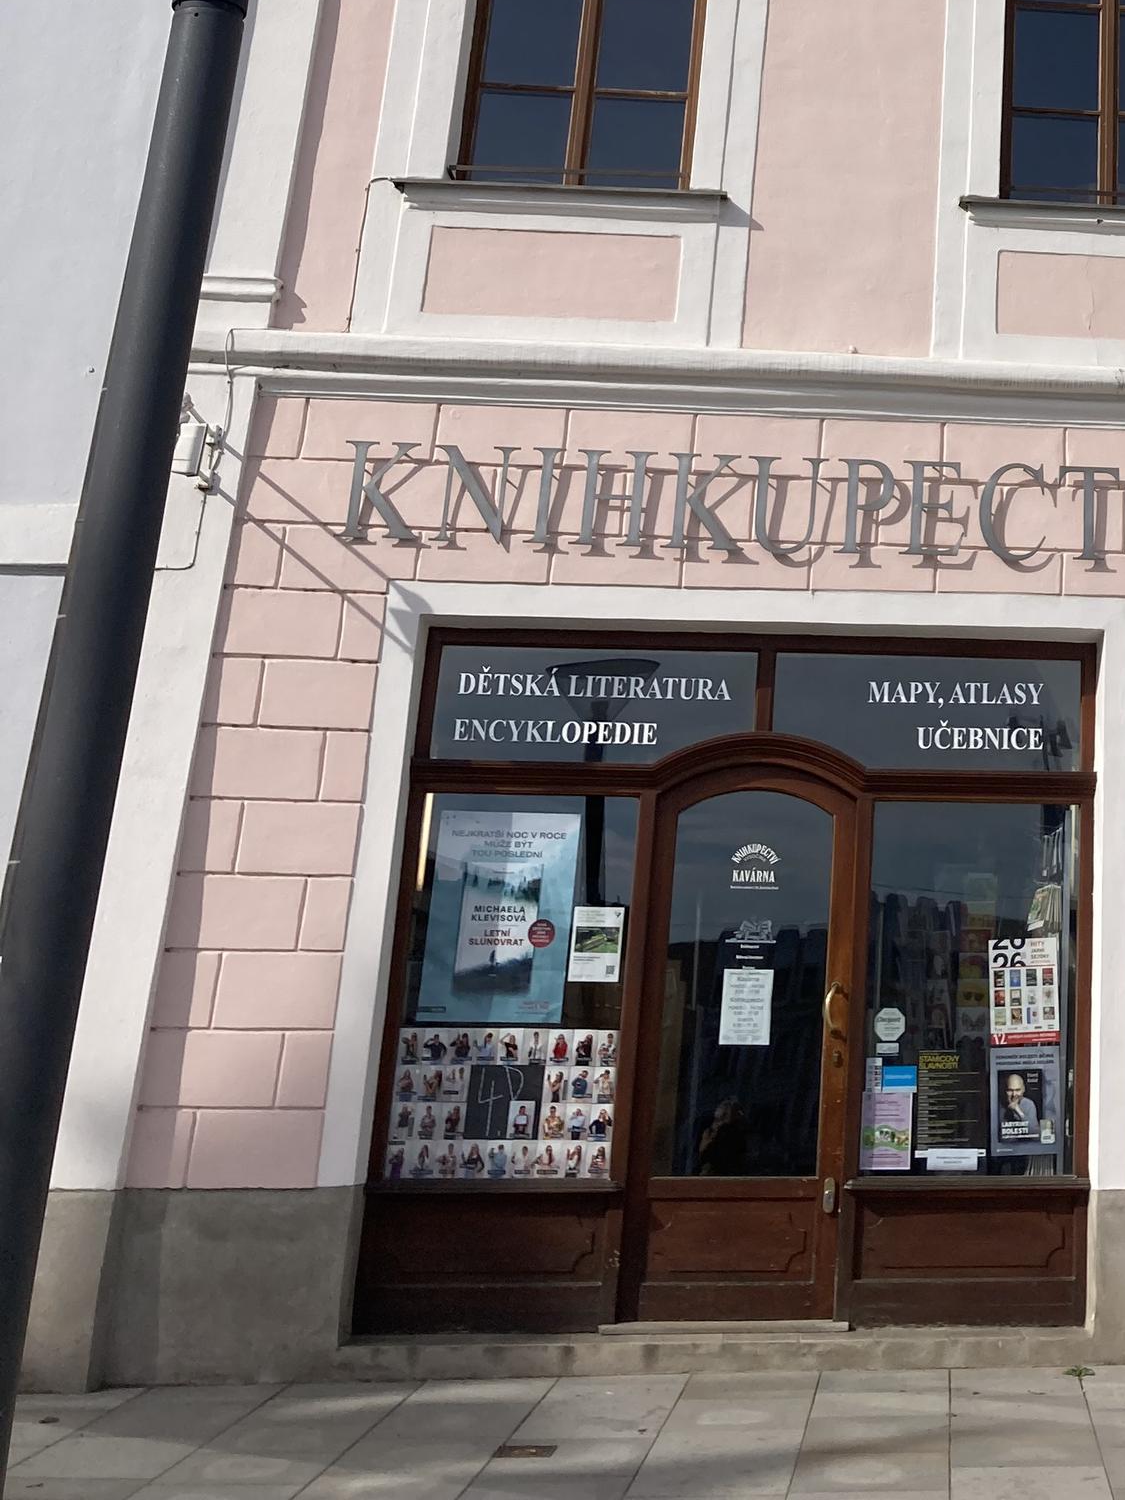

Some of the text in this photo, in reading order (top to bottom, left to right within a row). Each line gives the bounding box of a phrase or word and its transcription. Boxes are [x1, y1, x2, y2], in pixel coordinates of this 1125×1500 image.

[457, 666, 732, 700] DĚTSKÁ LITERATURA
[868, 681, 1044, 708] MAPY, ATLASY
[453, 718, 657, 745] ENCYKLOPEDIE
[916, 720, 1044, 750] UČEBNICE
[472, 849, 543, 858] TOU POSLEDNÍ
[731, 843, 781, 864] KNIHKUPECTVÍ
[732, 867, 775, 883] KAVÁRNA
[474, 905, 525, 913] MICHAELA
[471, 913, 527, 922] KLEVISOVÁ
[484, 928, 511, 937] LETNÍ
[469, 938, 525, 946] SLUNOVRAT
